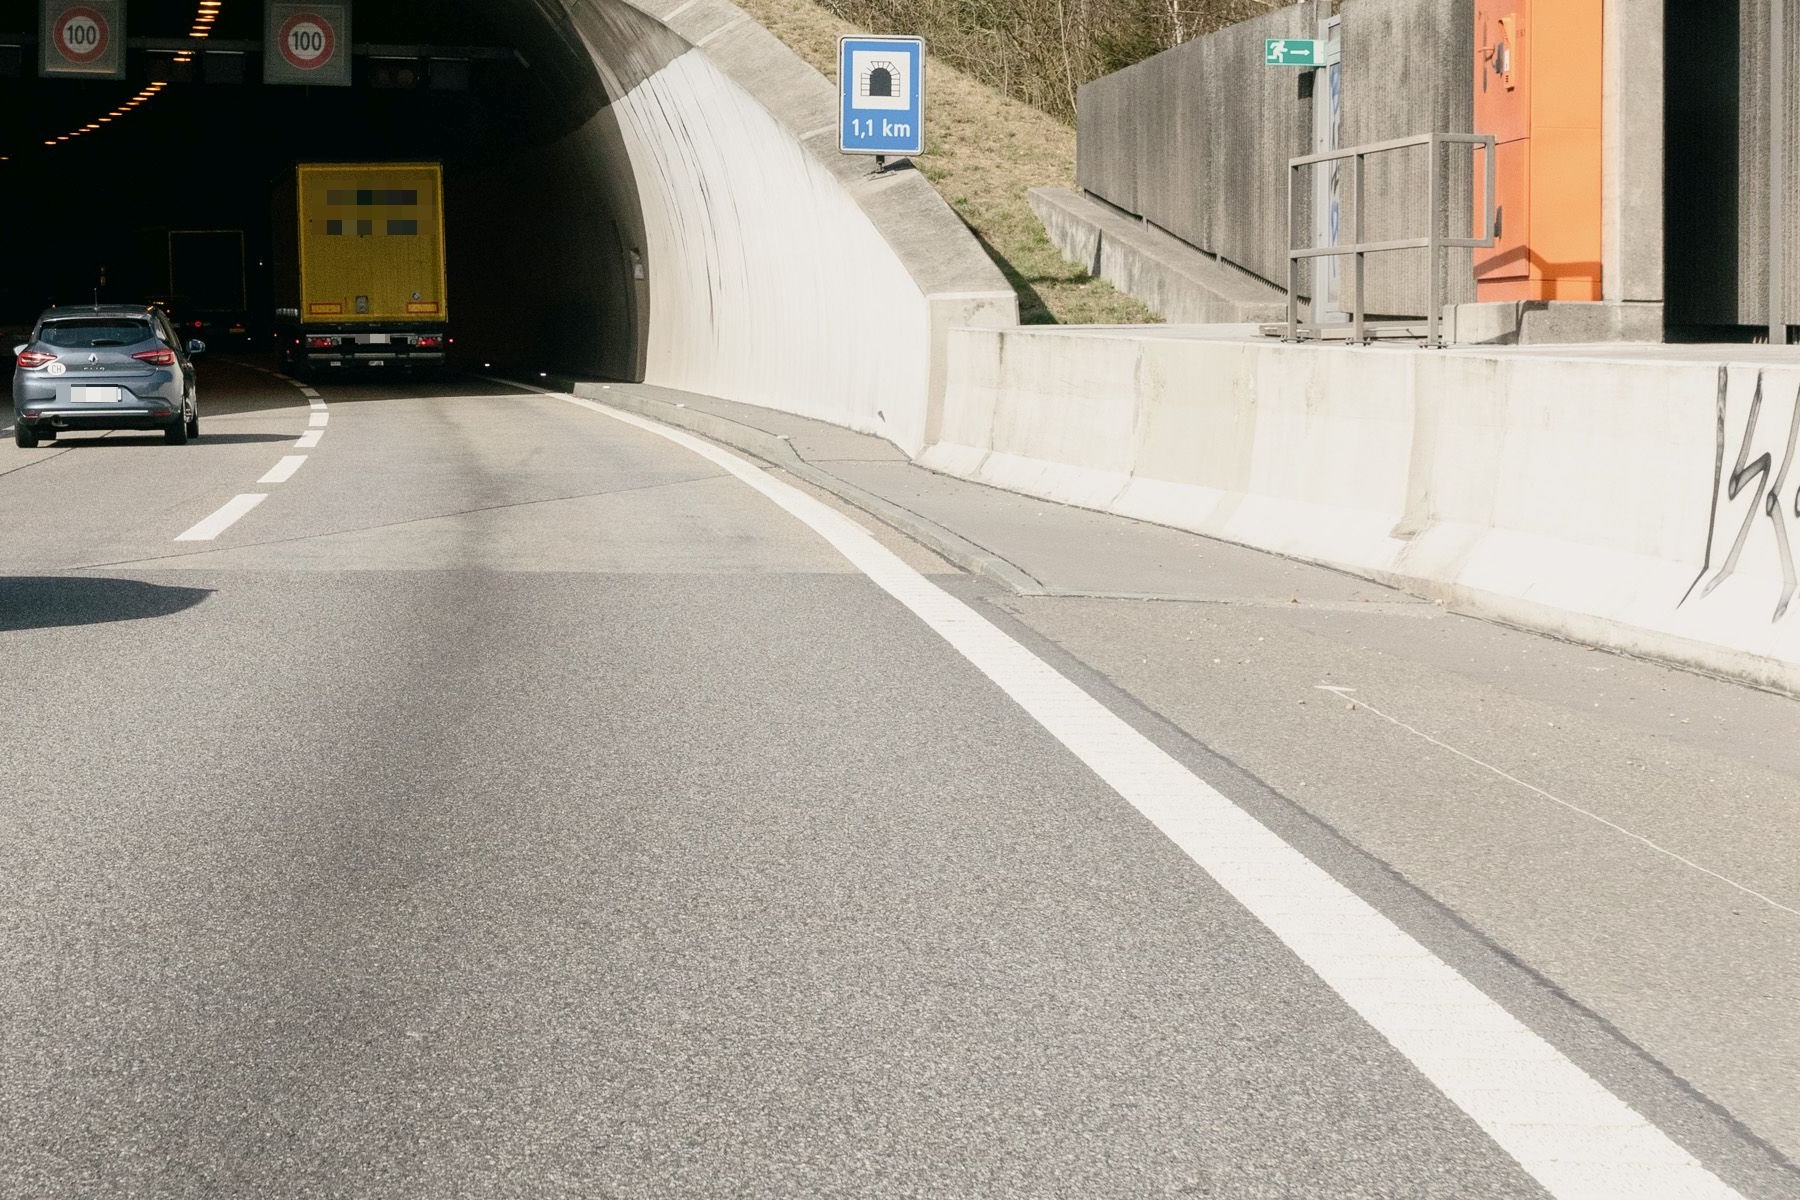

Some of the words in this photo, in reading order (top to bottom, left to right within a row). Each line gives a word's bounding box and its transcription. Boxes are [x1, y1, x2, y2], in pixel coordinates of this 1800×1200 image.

[66, 24, 97, 46] 100
[291, 31, 322, 52] 100
[851, 118, 873, 139] 1,1
[882, 118, 911, 138] km
[51, 364, 62, 373] CH
